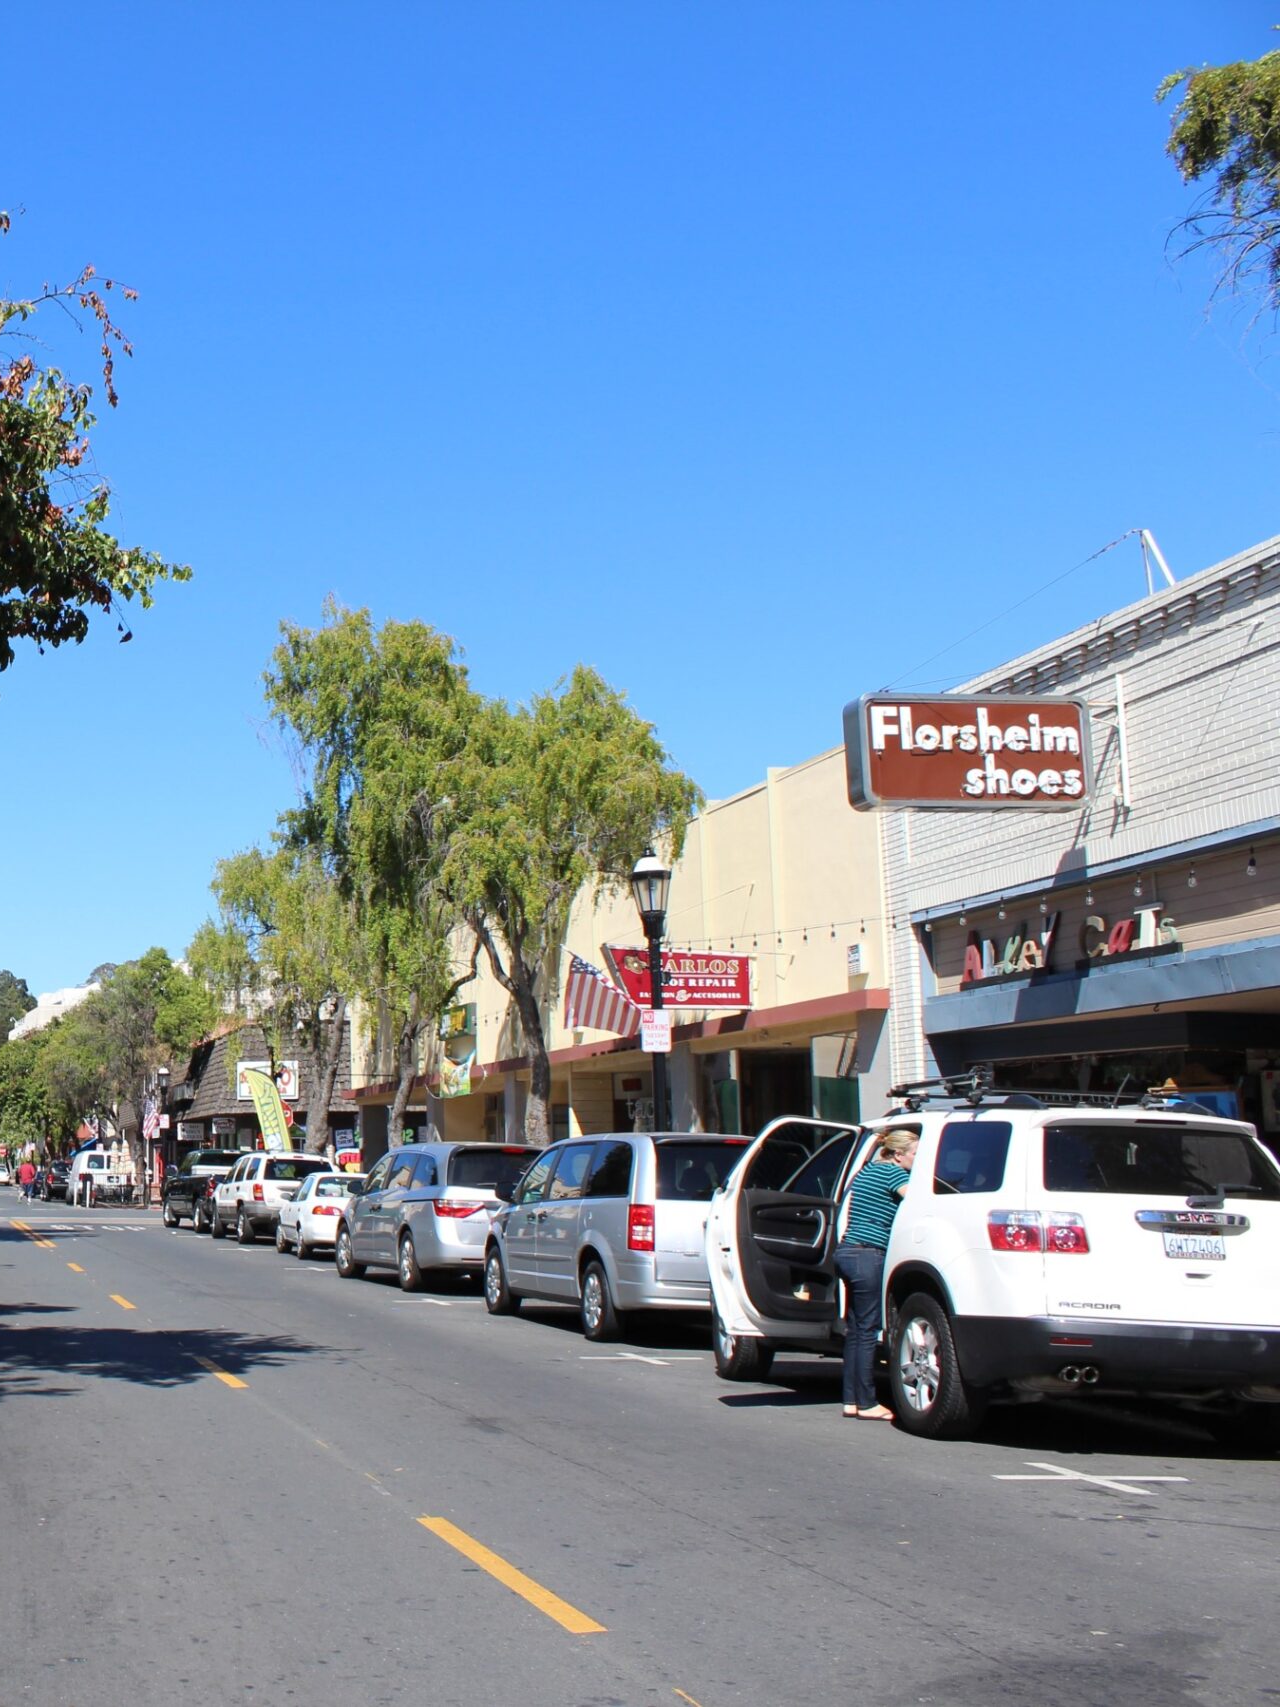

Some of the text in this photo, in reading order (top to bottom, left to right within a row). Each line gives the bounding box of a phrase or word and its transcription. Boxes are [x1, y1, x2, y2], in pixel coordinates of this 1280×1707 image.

[870, 706, 1080, 753] Florsheim
[963, 753, 1083, 796] shoes
[660, 958, 740, 974] ARLOS
[688, 978, 737, 987] REPAIR
[643, 1012, 654, 1021] NO
[644, 1023, 669, 1031] PARKING
[1176, 1213, 1217, 1223] GMC
[1058, 1301, 1121, 1310] ACADIA
